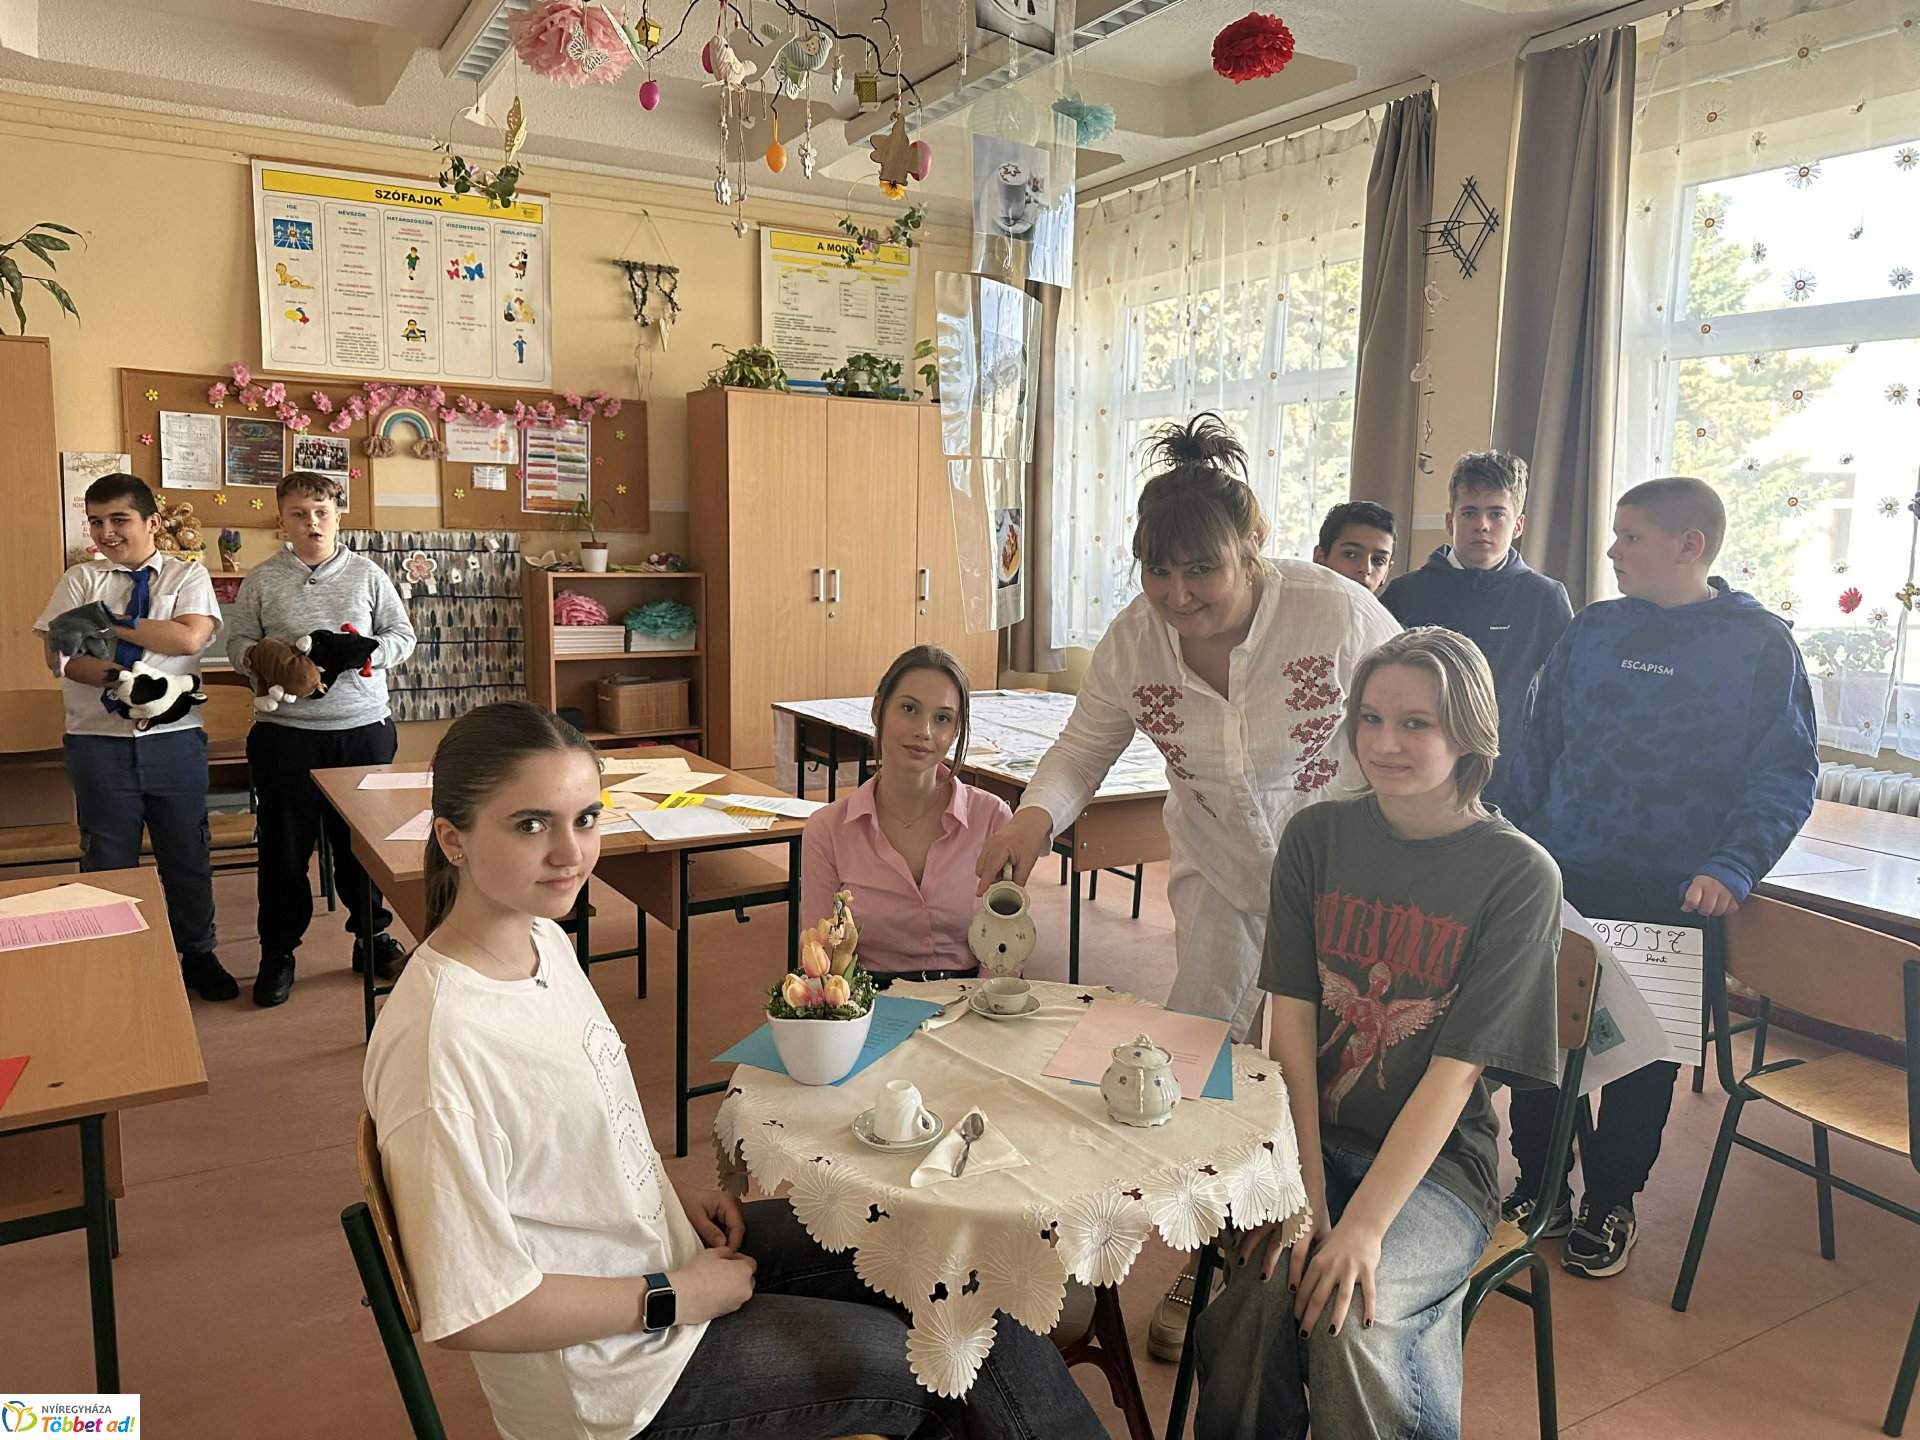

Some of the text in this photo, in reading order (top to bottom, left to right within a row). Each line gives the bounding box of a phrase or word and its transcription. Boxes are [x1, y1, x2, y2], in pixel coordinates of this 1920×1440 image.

[374, 188, 443, 207] SZÓFAJOK
[817, 242, 824, 250] A
[1620, 659, 1674, 676] ESCAPISM
